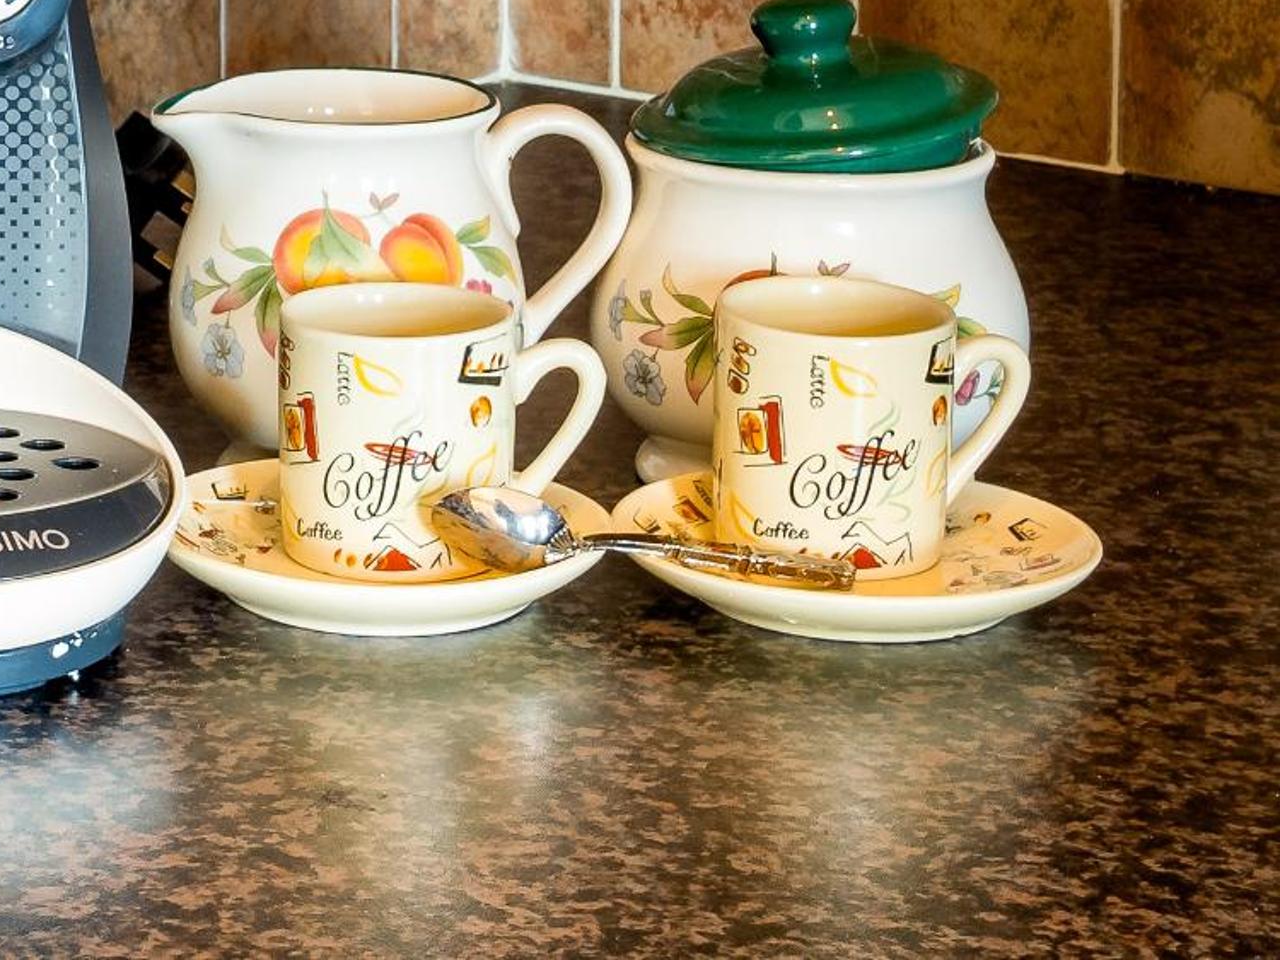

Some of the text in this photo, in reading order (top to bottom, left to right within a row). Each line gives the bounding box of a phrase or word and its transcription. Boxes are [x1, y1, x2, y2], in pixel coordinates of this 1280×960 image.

[810, 355, 829, 409] Latte
[323, 430, 450, 521] Coffee
[789, 430, 918, 521] Coffee
